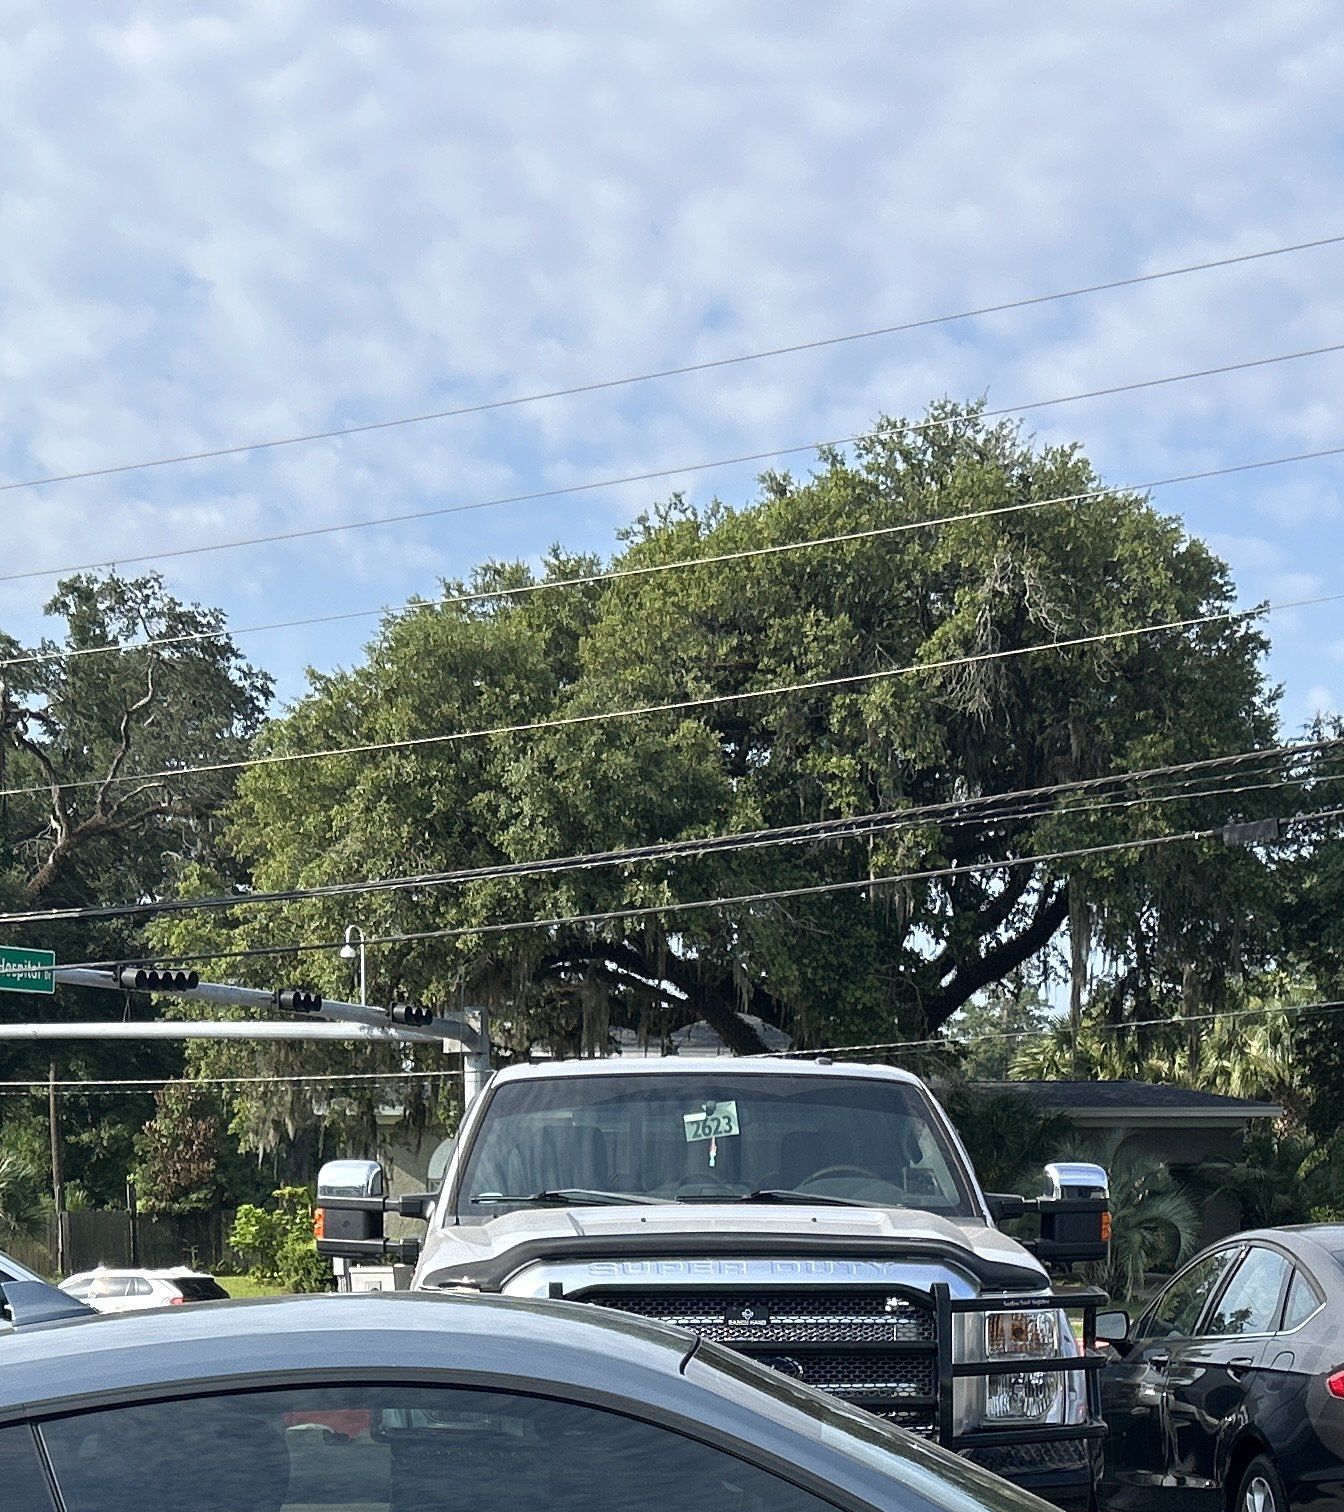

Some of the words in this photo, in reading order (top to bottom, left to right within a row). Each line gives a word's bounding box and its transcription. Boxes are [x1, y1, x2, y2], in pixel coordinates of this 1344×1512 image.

[691, 1115, 733, 1138] 2623
[587, 1260, 747, 1276] SUPER
[770, 1260, 895, 1275] DUTY
